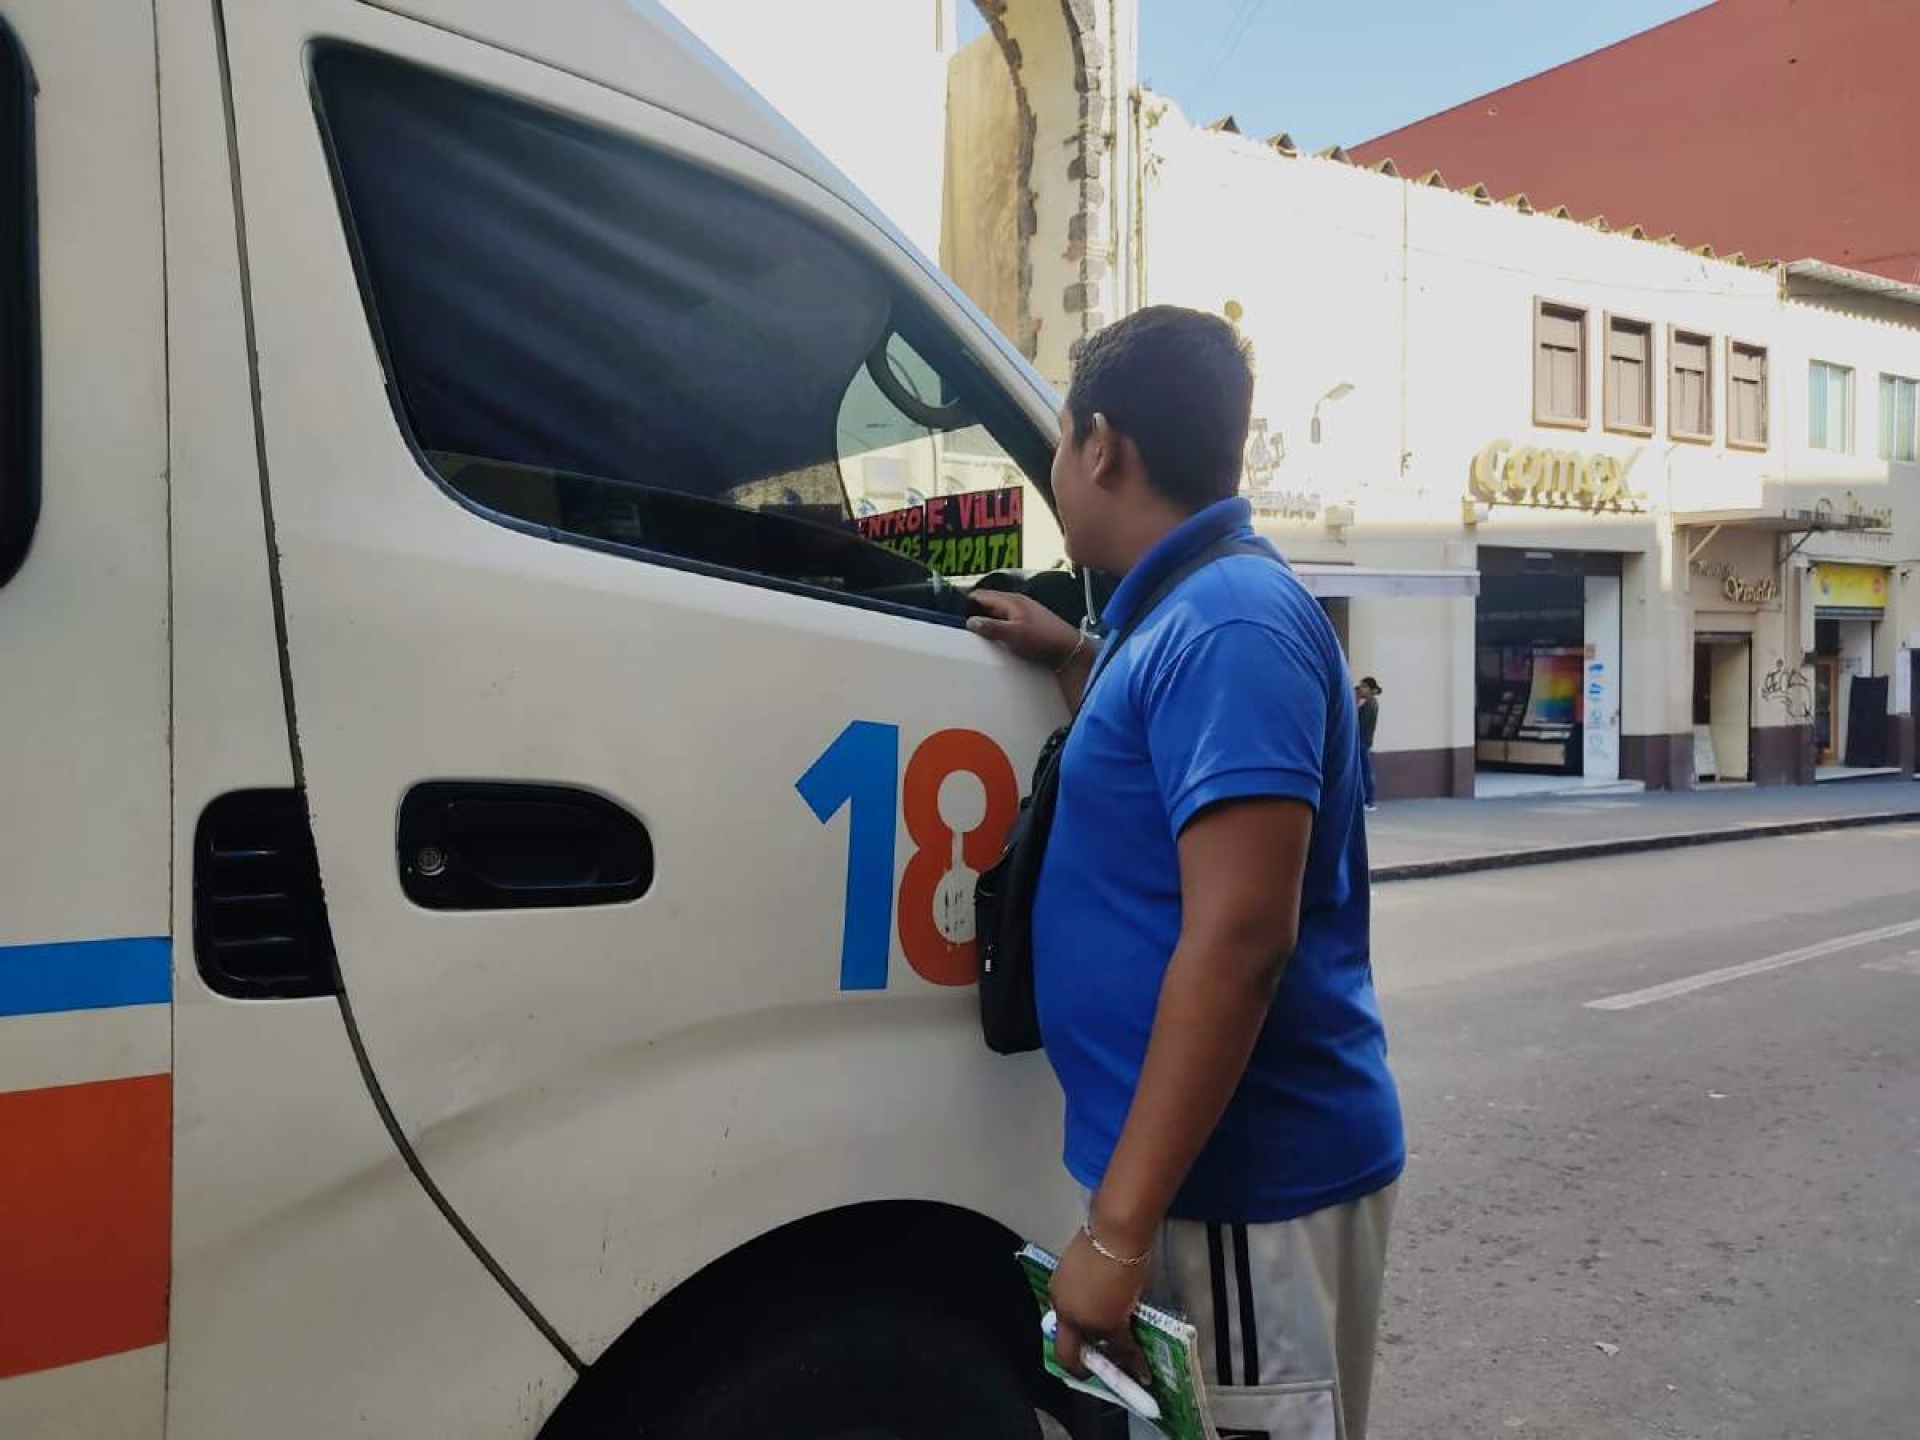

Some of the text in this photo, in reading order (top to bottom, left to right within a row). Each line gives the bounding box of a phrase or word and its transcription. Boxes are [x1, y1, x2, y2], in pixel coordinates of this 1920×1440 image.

[856, 506, 921, 538] ENTRO
[928, 533, 1019, 574] ZAPATA
[795, 719, 1020, 991] 18
